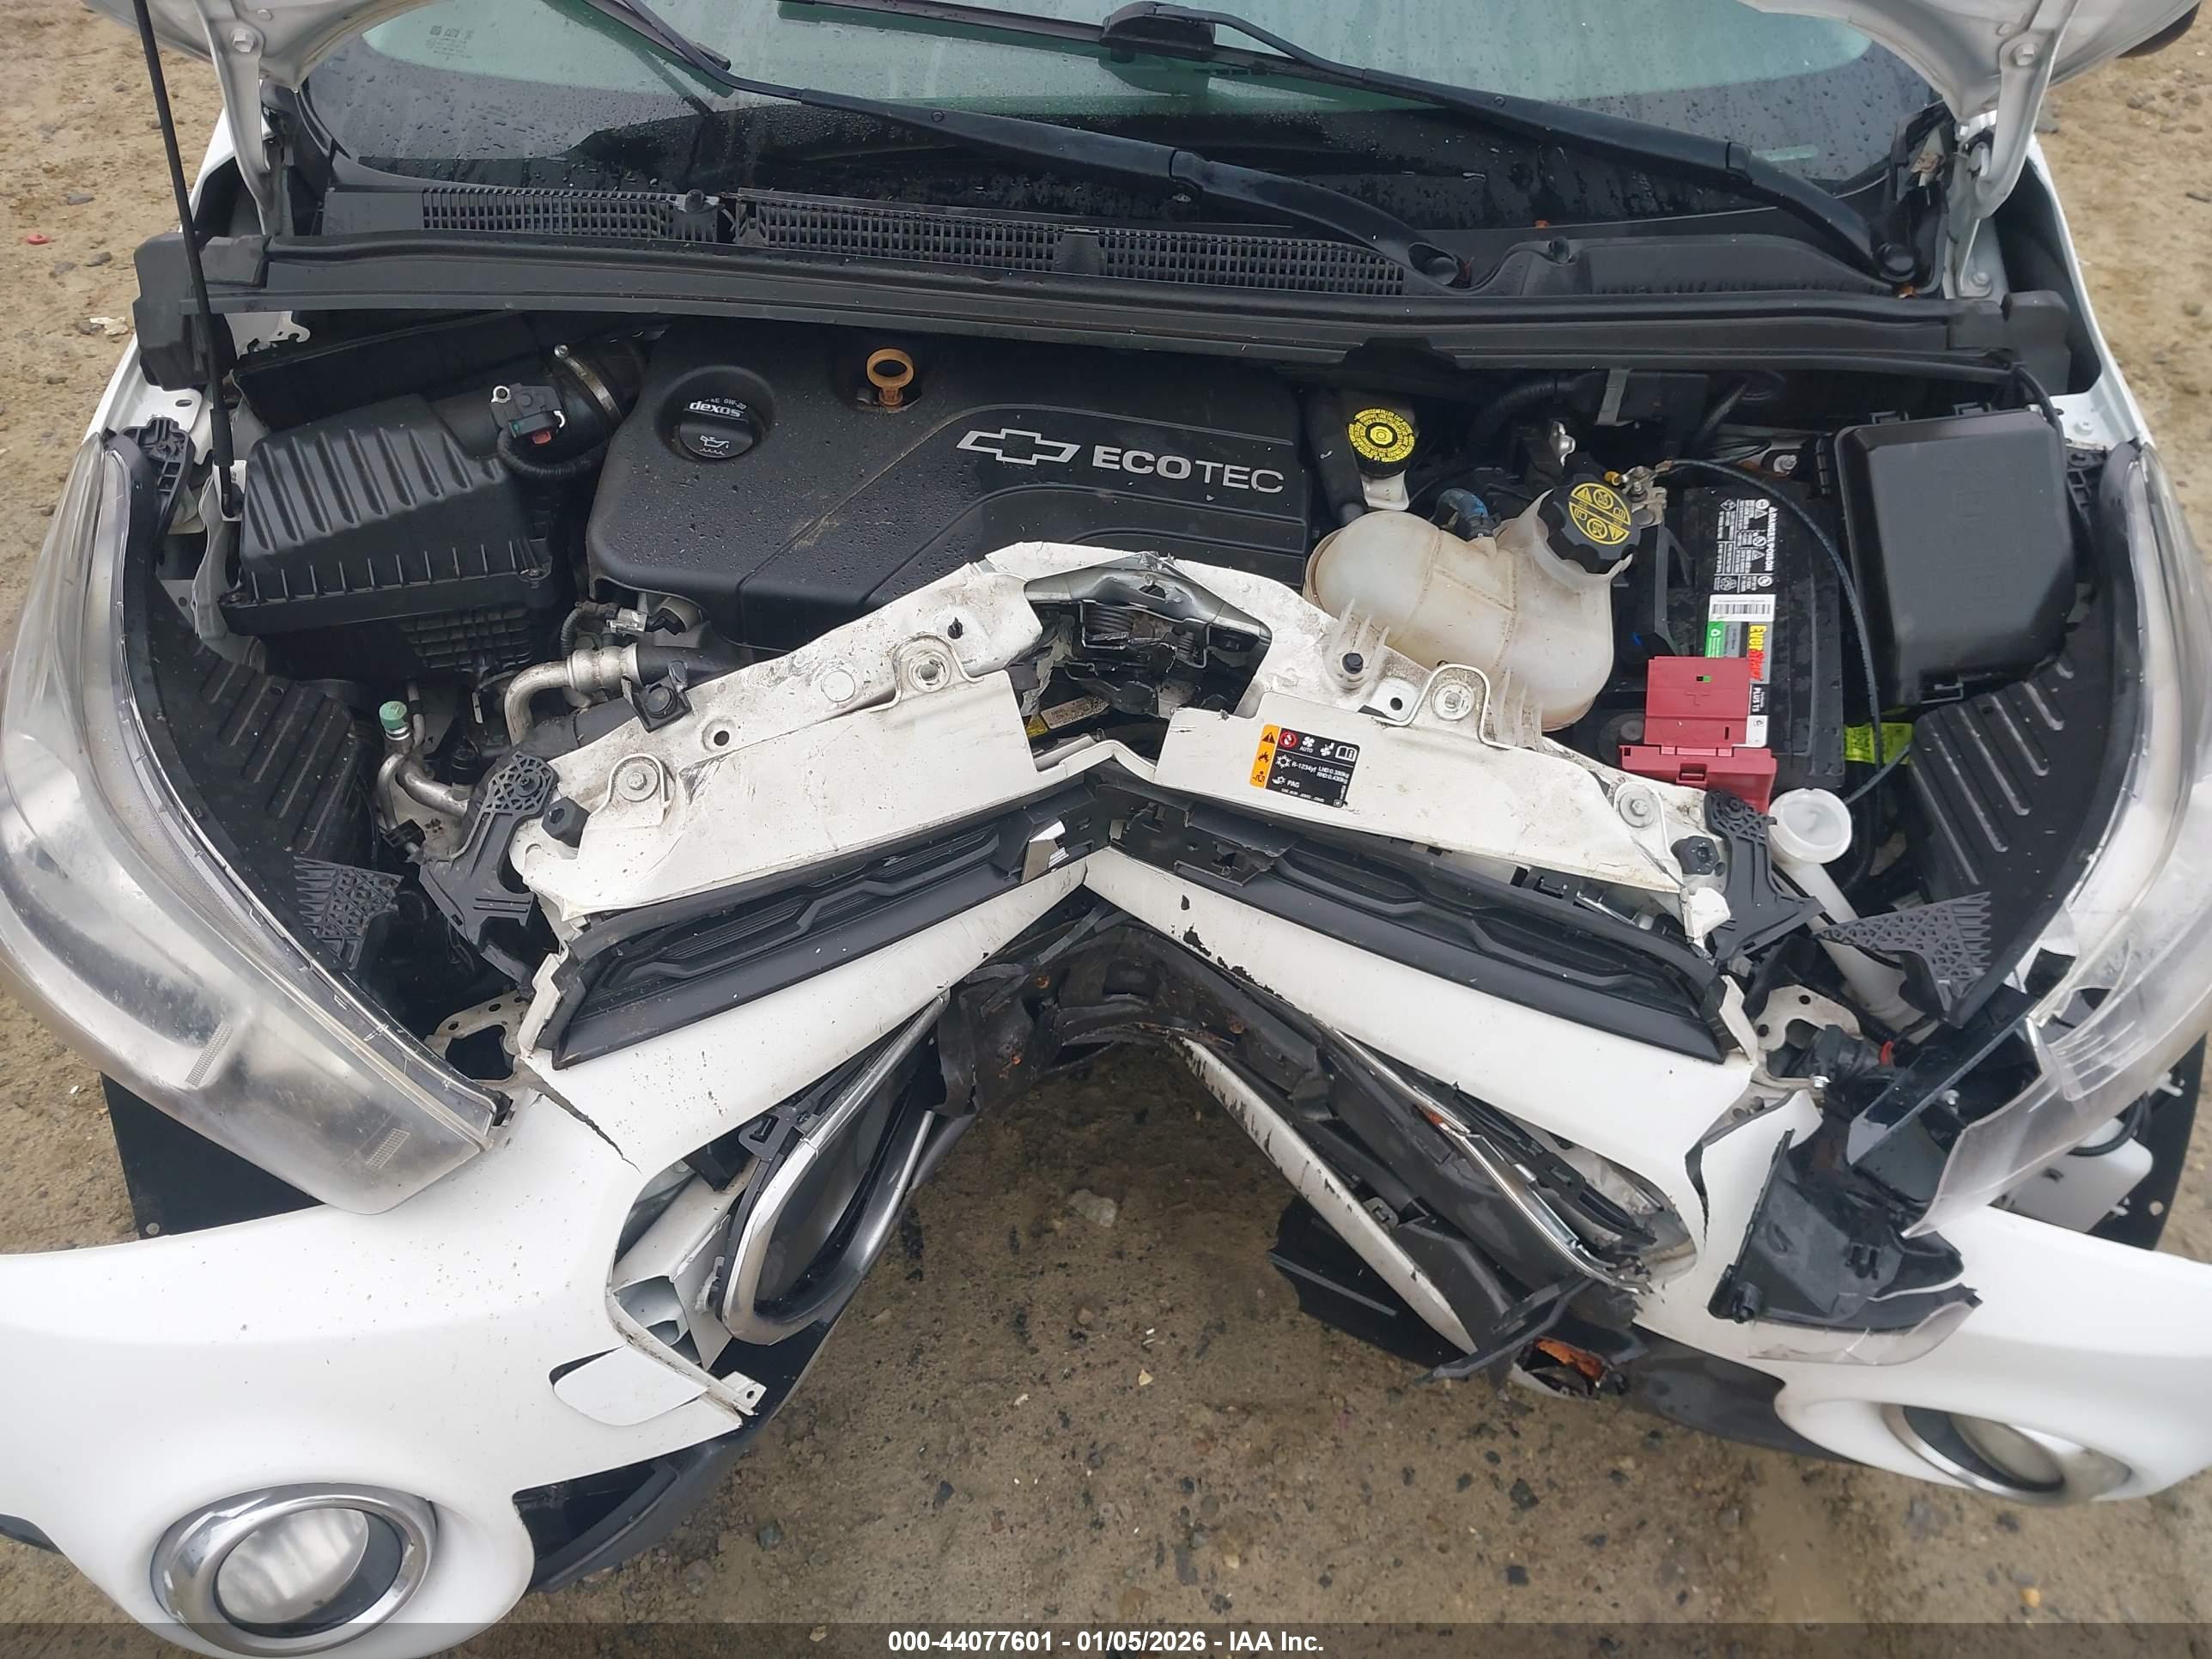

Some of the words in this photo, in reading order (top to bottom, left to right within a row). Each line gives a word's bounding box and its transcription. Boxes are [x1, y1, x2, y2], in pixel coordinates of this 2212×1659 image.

[689, 400, 744, 418] dexos
[723, 398, 747, 410] 0W-20
[1091, 444, 1285, 494] ECOTEC
[1752, 687, 1761, 703] PLUS
[1291, 761, 1317, 774] R-1234yf
[1286, 780, 1300, 788] PAG
